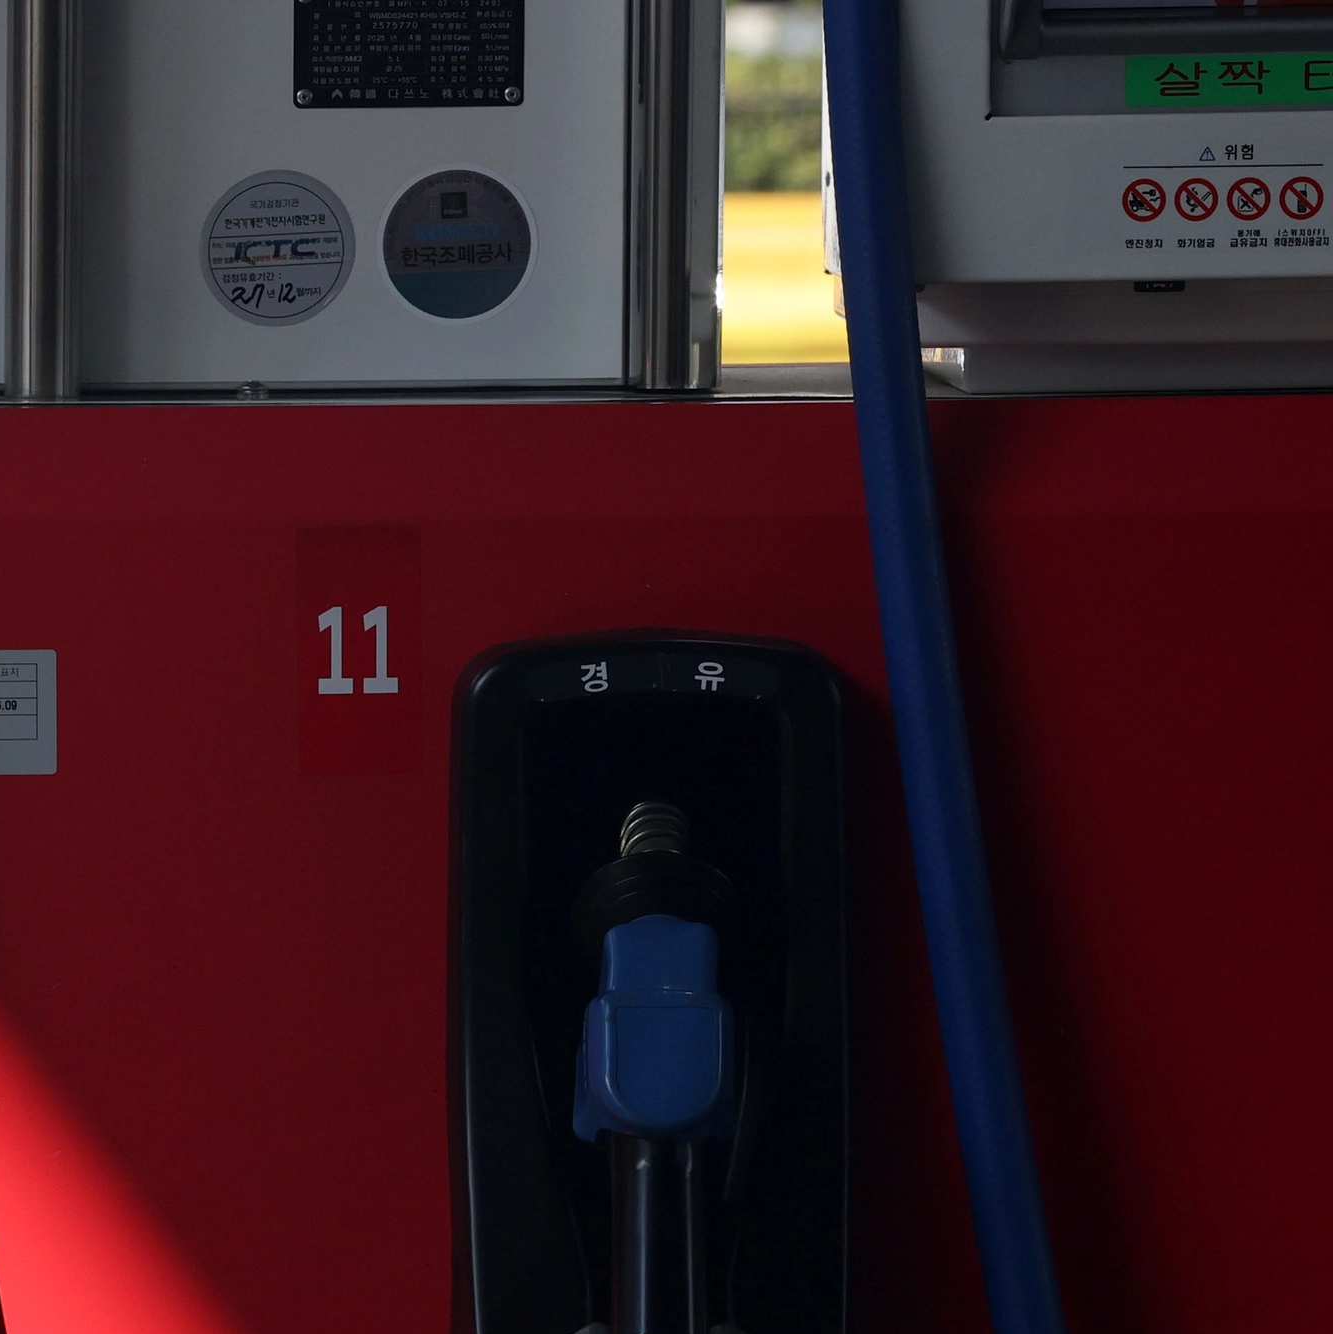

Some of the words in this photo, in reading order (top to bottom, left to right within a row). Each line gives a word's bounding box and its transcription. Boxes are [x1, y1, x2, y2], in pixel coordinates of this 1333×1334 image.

[1154, 60, 1271, 97] 살짝
[1224, 144, 1255, 160] 위험
[250, 198, 300, 209] 국가검정기관
[225, 215, 326, 229] 한국기계전기전자시험연구원
[1125, 238, 1163, 249] 엔진정지
[1177, 238, 1215, 248] 화기엄금
[1230, 238, 1267, 247] 급유금지
[1274, 238, 1329, 246] 휴대전화사용금지
[234, 239, 315, 265] KTC
[401, 242, 513, 267] 한국조폐공사
[222, 272, 275, 283] 검정유효기간
[232, 283, 265, 308] 27
[267, 289, 275, 298] 년
[278, 283, 296, 303] 12
[316, 605, 400, 695] 11
[0, 666, 19, 677] 표지
